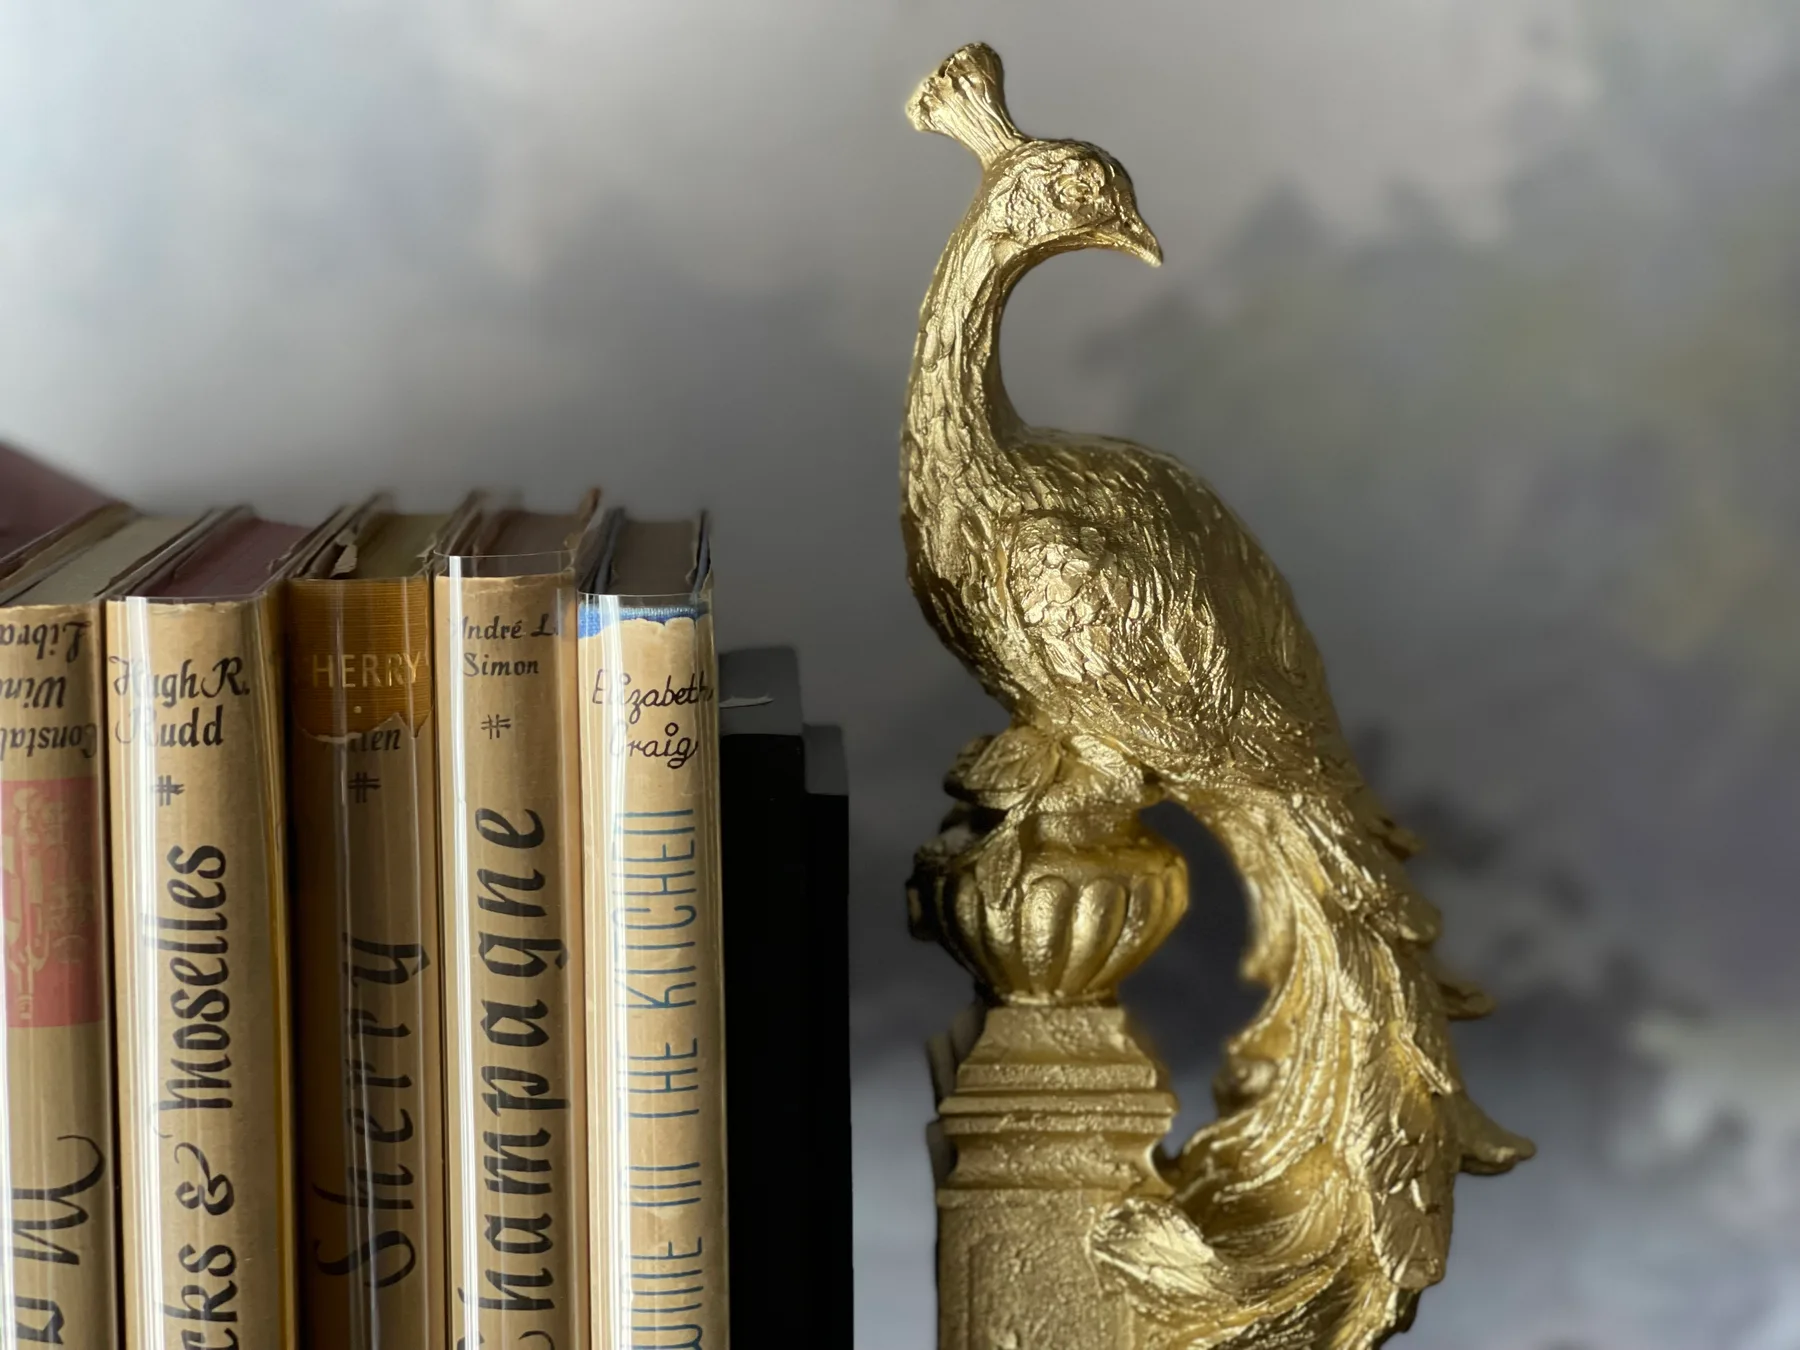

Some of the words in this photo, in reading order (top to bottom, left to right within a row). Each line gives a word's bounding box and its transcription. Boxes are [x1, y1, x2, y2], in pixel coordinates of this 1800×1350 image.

[0, 676, 66, 709] Win
[109, 656, 200, 708] Hugh
[462, 652, 540, 677] Simon
[115, 705, 224, 747] Rudd
[611, 721, 698, 769] Craig
[612, 809, 697, 1010] KITCHEN
[143, 845, 233, 1138] Moselles
[312, 931, 430, 1288] Sherry
[616, 1038, 699, 1132] THE
[174, 1142, 235, 1216] &
